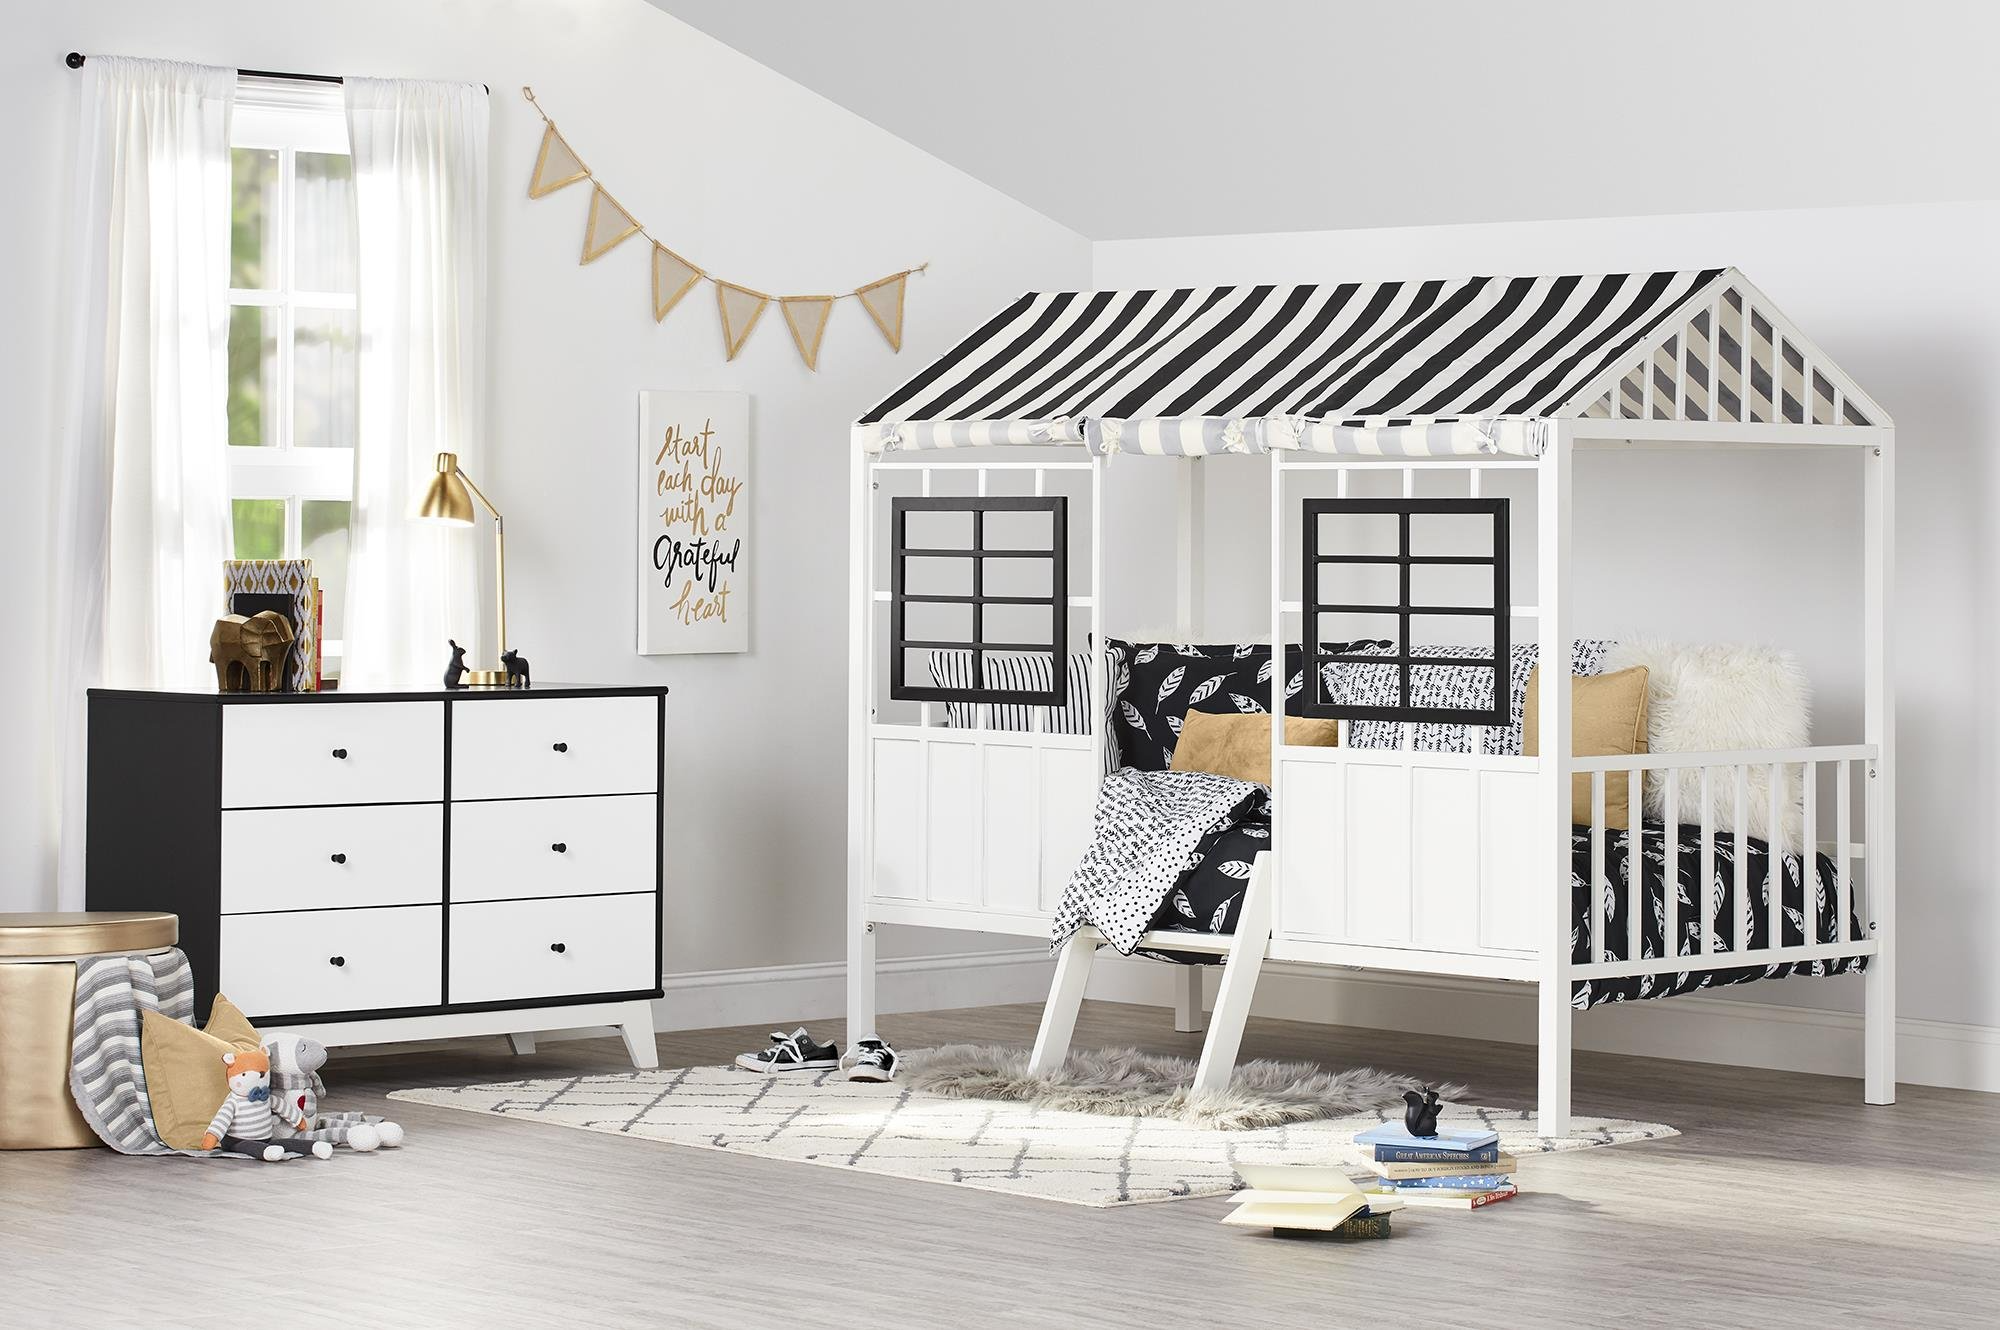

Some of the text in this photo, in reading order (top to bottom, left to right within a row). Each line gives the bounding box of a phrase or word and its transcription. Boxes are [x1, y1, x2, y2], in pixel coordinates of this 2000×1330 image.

[657, 447, 743, 517] each day
[659, 489, 727, 537] with a
[670, 580, 731, 626] heart
